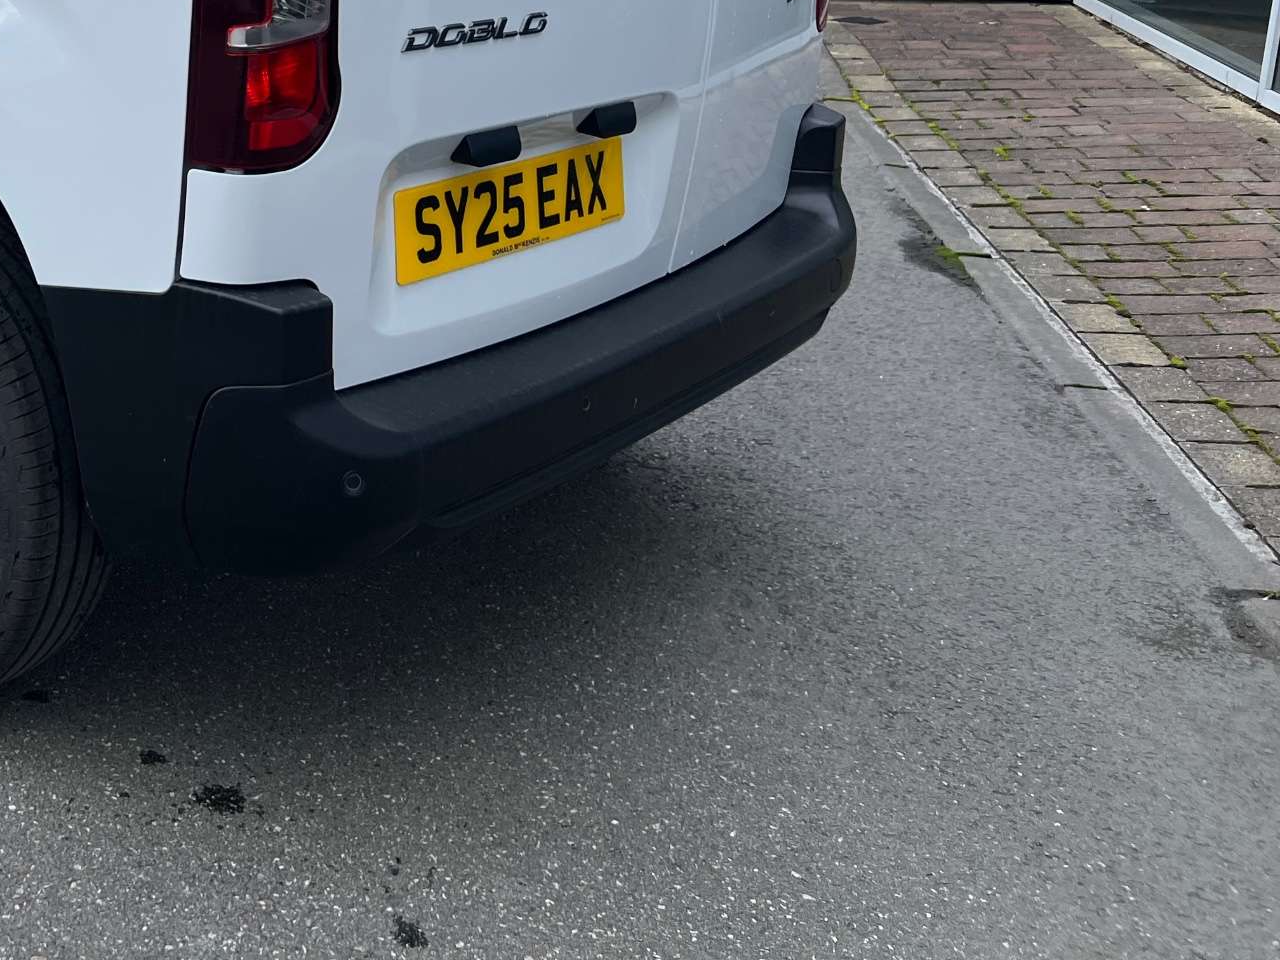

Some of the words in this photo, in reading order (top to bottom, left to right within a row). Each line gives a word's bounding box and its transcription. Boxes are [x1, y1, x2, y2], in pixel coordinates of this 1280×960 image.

[400, 10, 549, 54] DOBLO
[415, 172, 526, 264] SY25
[536, 150, 608, 230] EAX
